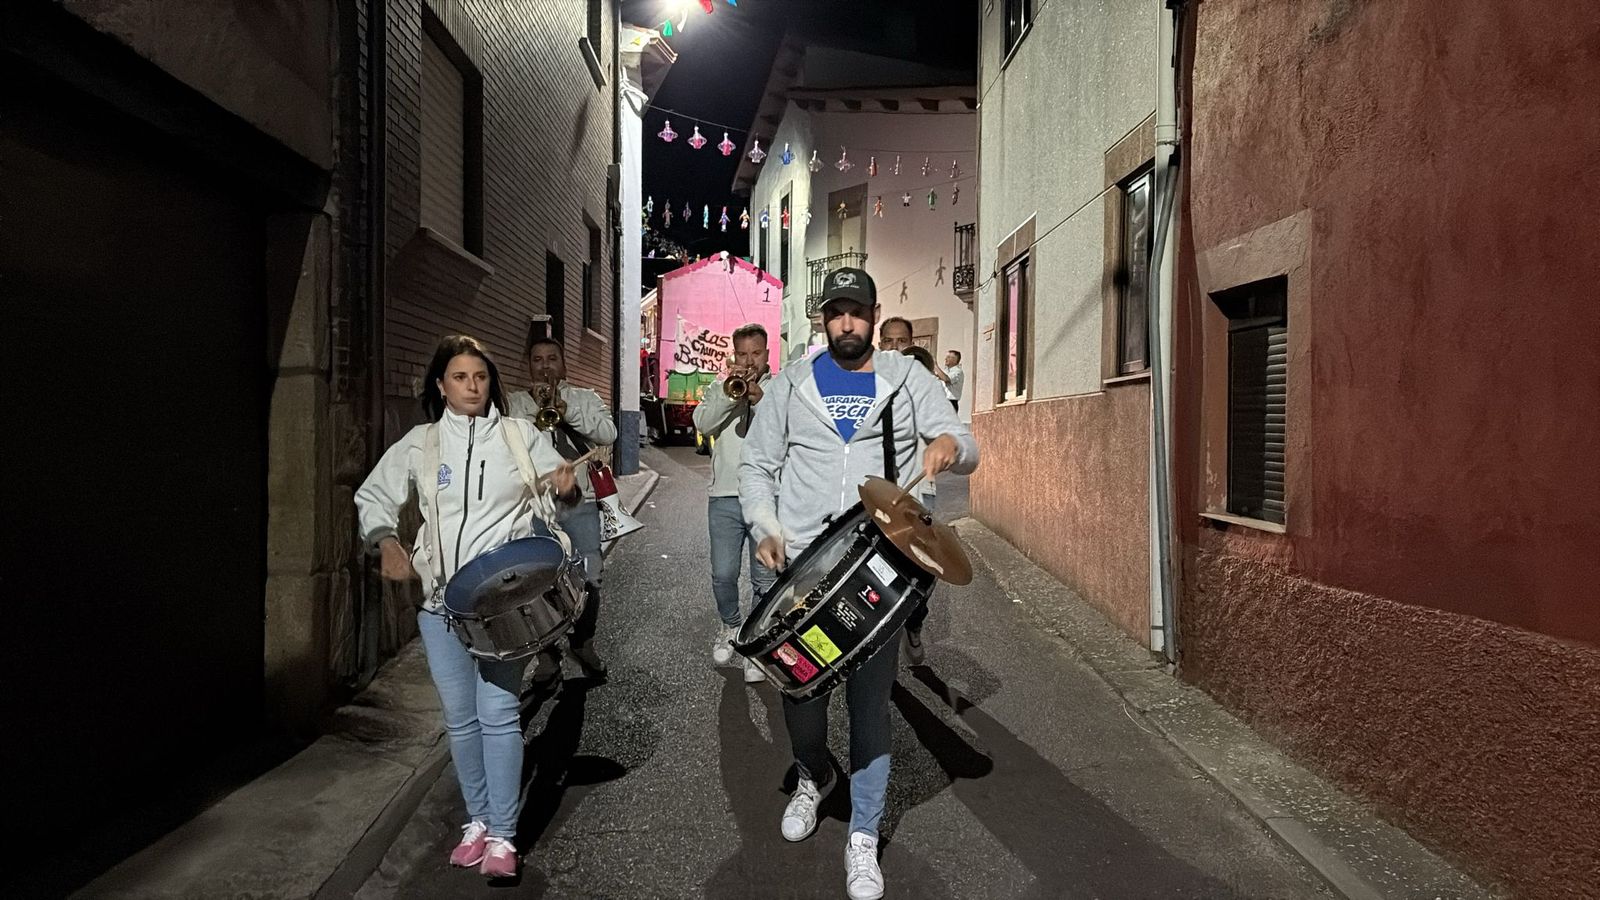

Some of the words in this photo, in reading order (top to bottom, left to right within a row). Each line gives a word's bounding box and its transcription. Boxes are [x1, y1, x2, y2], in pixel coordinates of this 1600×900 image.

[762, 287, 771, 302] 1
[698, 329, 731, 348] Las
[691, 339, 728, 362] Chung
